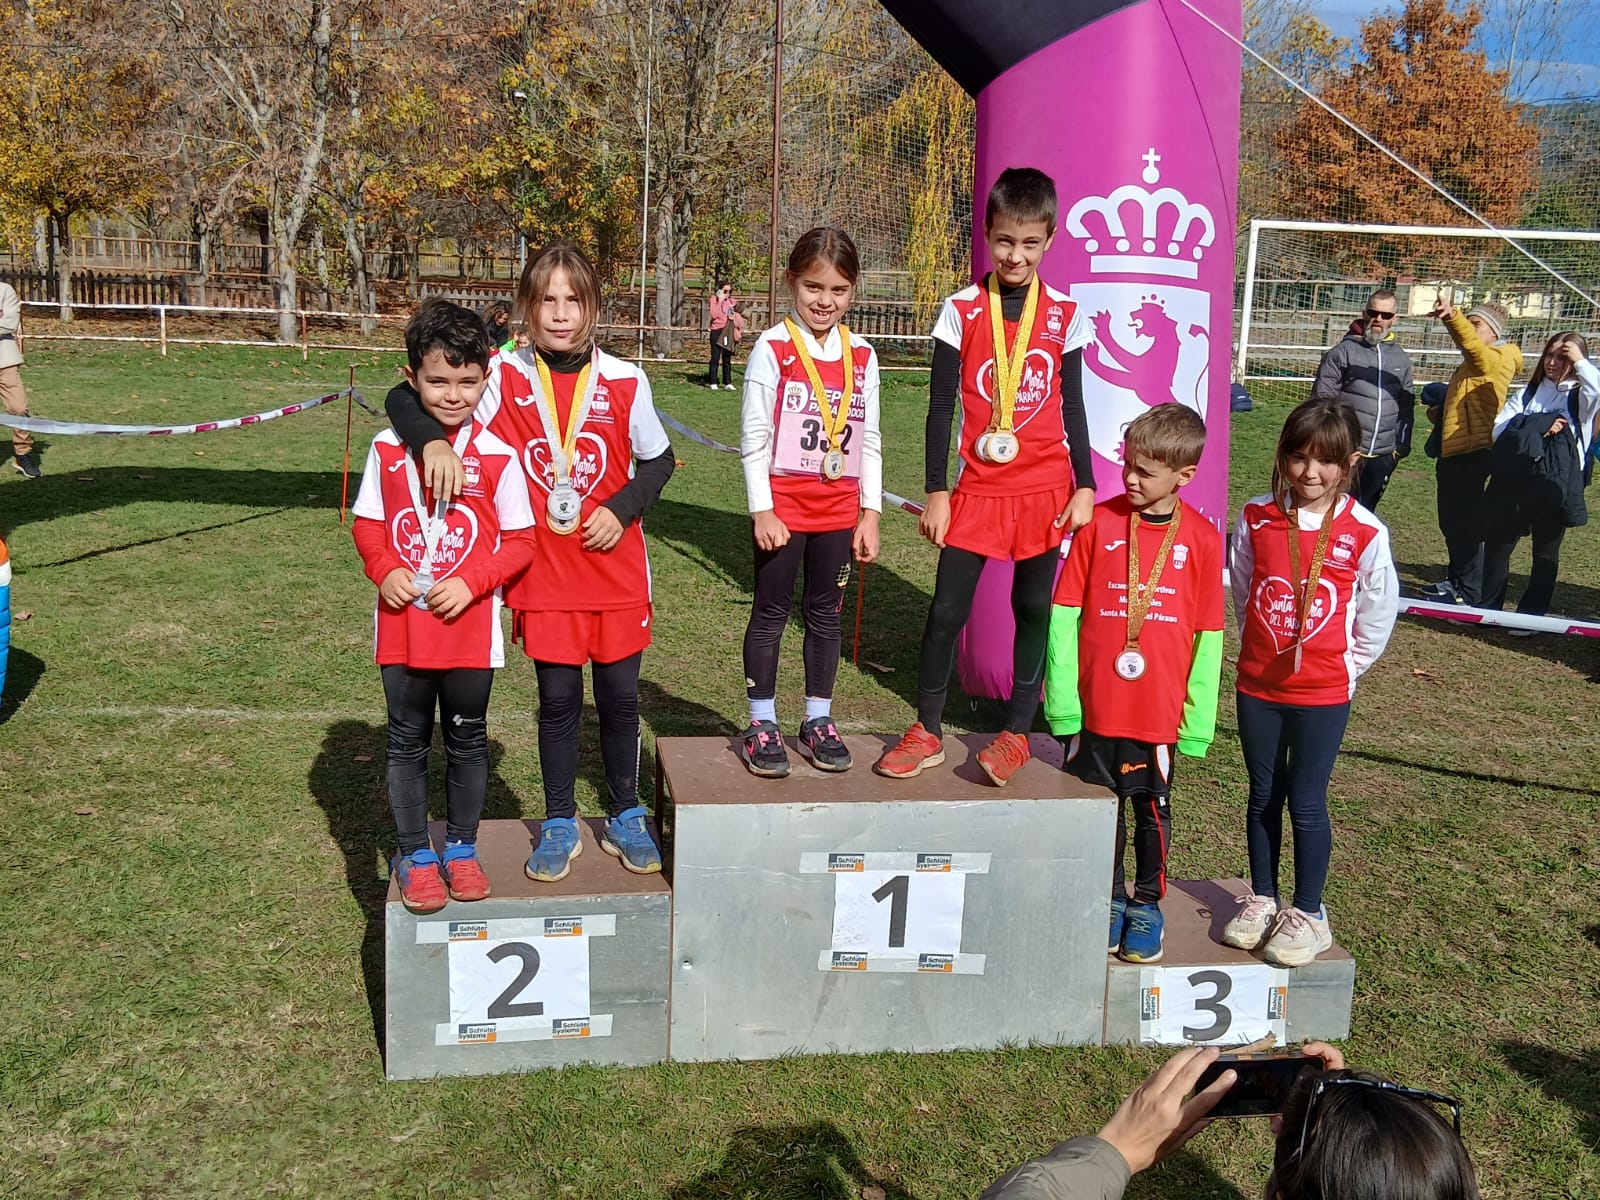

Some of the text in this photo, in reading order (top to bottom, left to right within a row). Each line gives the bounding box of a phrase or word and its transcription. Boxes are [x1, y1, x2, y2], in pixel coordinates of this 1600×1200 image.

[534, 447, 554, 477] San
[1265, 586, 1295, 613] Santa
[1269, 613, 1281, 626] DEL
[871, 875, 909, 948] 1
[486, 941, 544, 1019] 2
[1183, 970, 1232, 1041] 3
